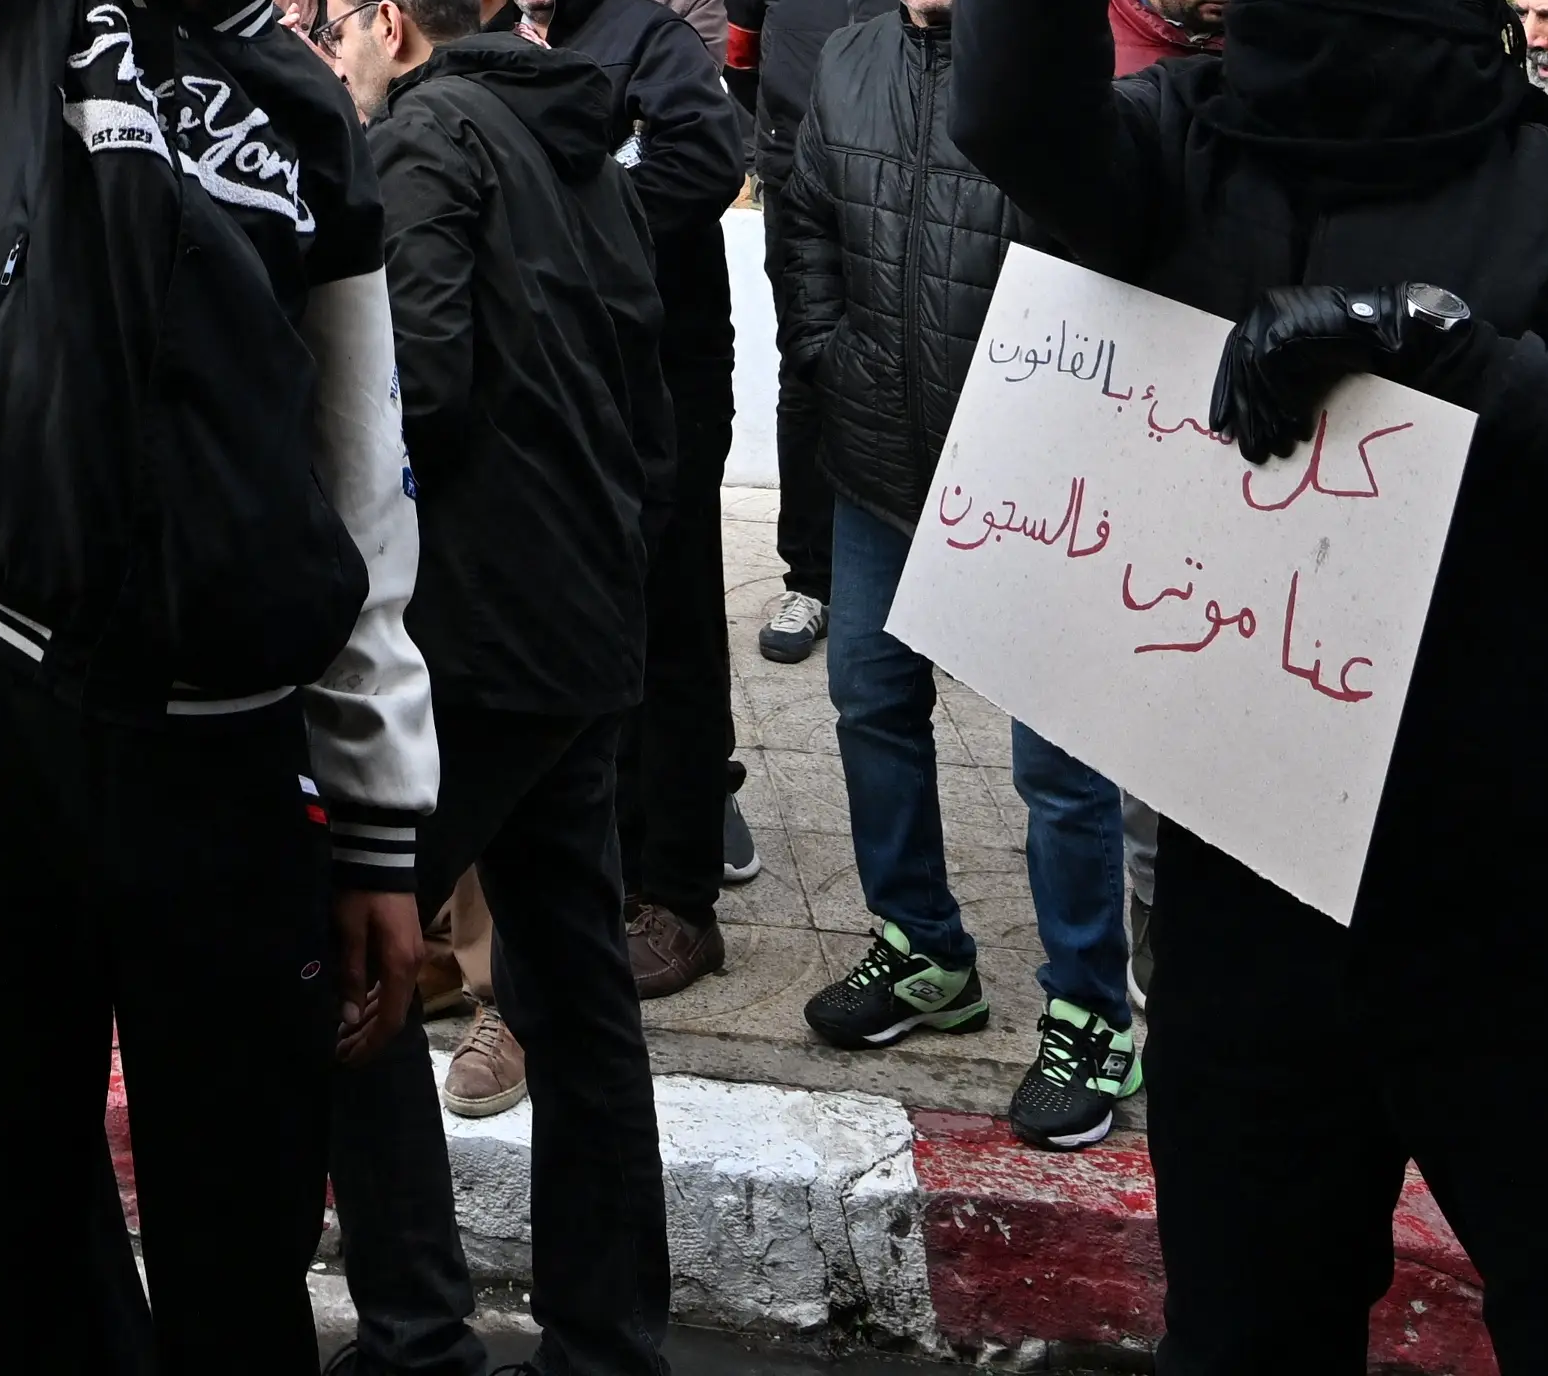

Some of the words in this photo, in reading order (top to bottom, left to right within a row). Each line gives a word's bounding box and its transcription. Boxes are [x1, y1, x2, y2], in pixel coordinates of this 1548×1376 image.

[989, 320, 1133, 413] بالقانون
[1243, 409, 1412, 512] كل
[940, 477, 1111, 558] فالسجون
[1281, 570, 1375, 703] عنا
